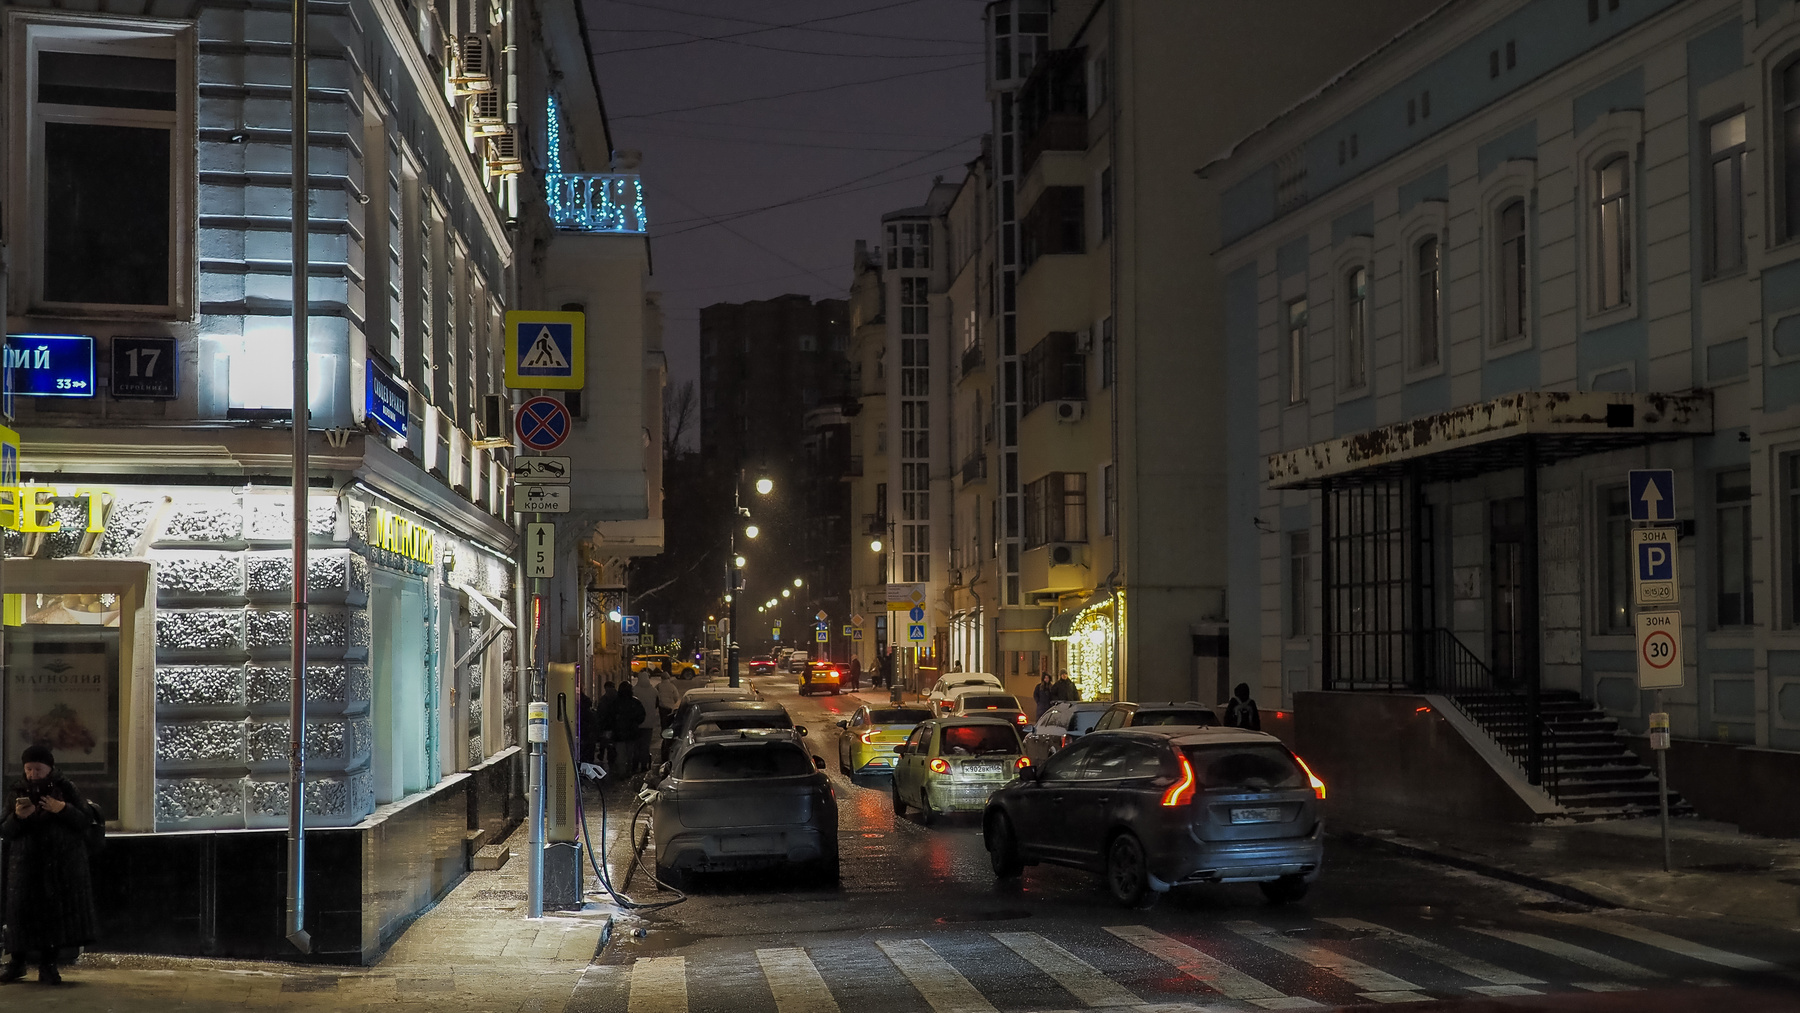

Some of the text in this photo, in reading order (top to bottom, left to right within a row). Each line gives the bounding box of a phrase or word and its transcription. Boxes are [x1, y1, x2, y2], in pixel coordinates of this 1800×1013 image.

[125, 348, 161, 377] 17
[56, 378, 71, 389] 33
[374, 506, 435, 565] МАГНОЛИЯ
[1642, 532, 1667, 541] ЗОНА
[536, 551, 545, 562] 5
[1659, 587, 1670, 596] 20
[1645, 617, 1671, 626] ЗОНА
[1650, 642, 1669, 658] 30
[15, 674, 101, 684] МАГНОЛИЯ
